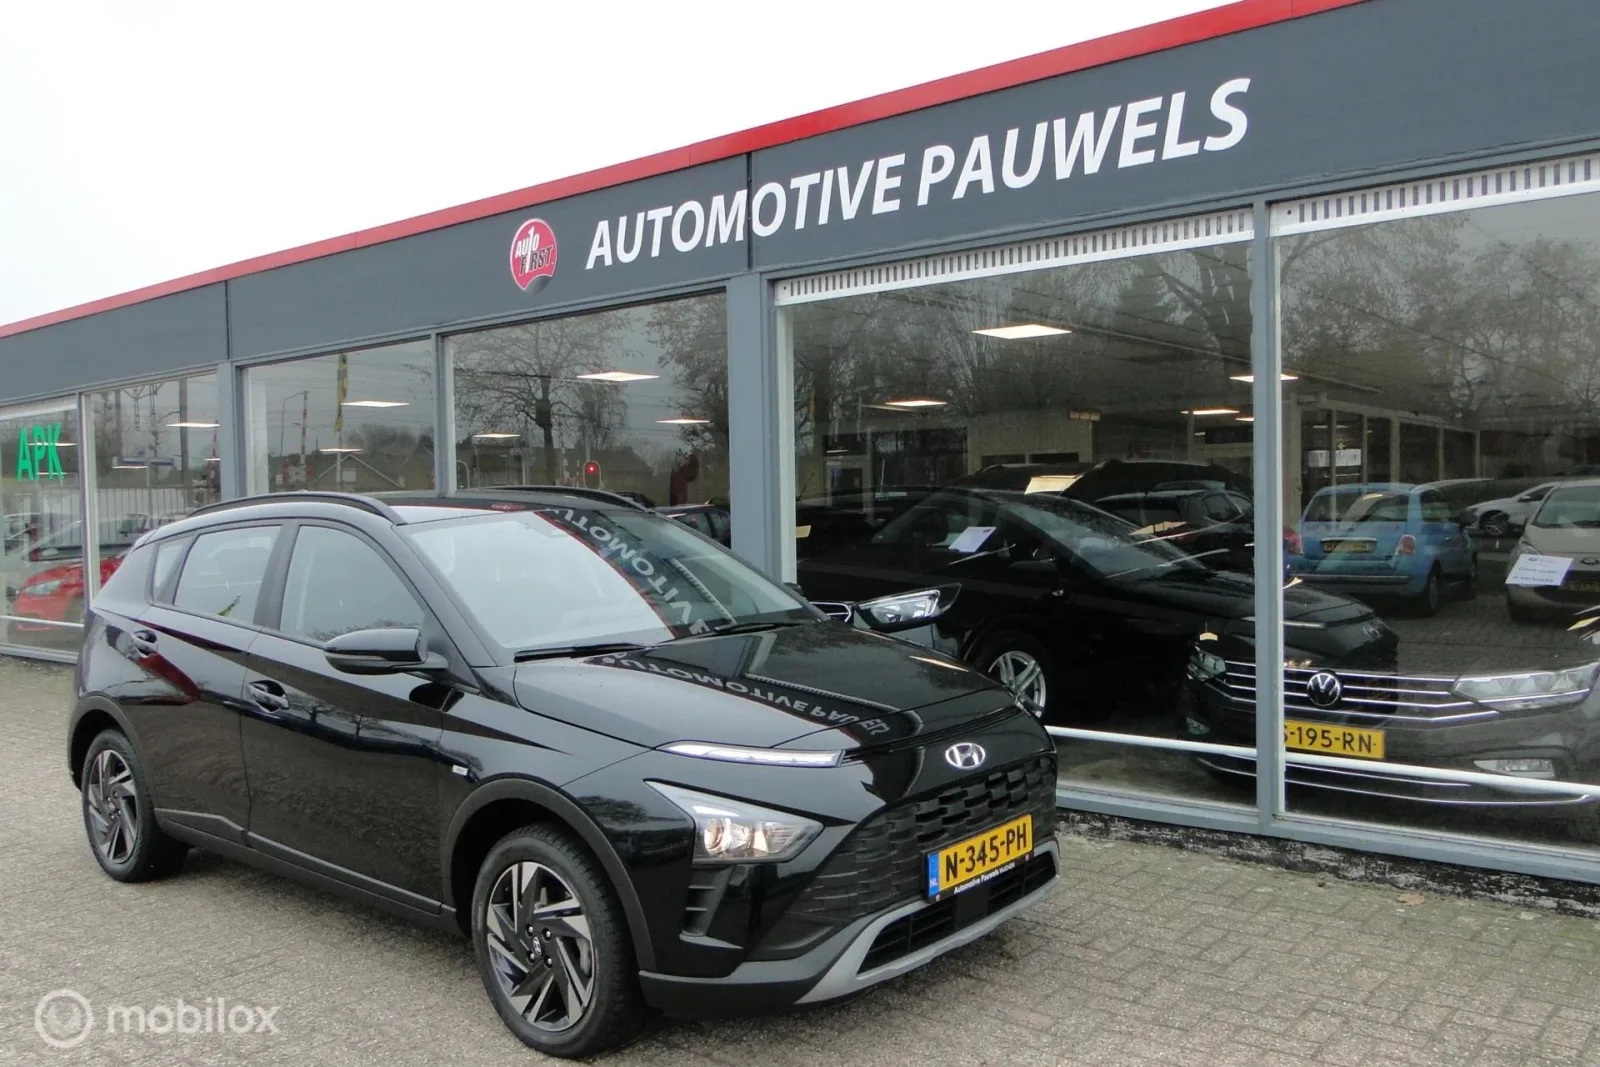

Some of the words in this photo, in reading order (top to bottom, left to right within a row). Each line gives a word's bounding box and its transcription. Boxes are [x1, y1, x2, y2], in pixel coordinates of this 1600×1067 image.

[585, 152, 906, 270] AUTOMOTIVE
[917, 77, 1251, 207] PAUWELS
[16, 423, 64, 481] APK
[945, 822, 1027, 883] N-345-PH
